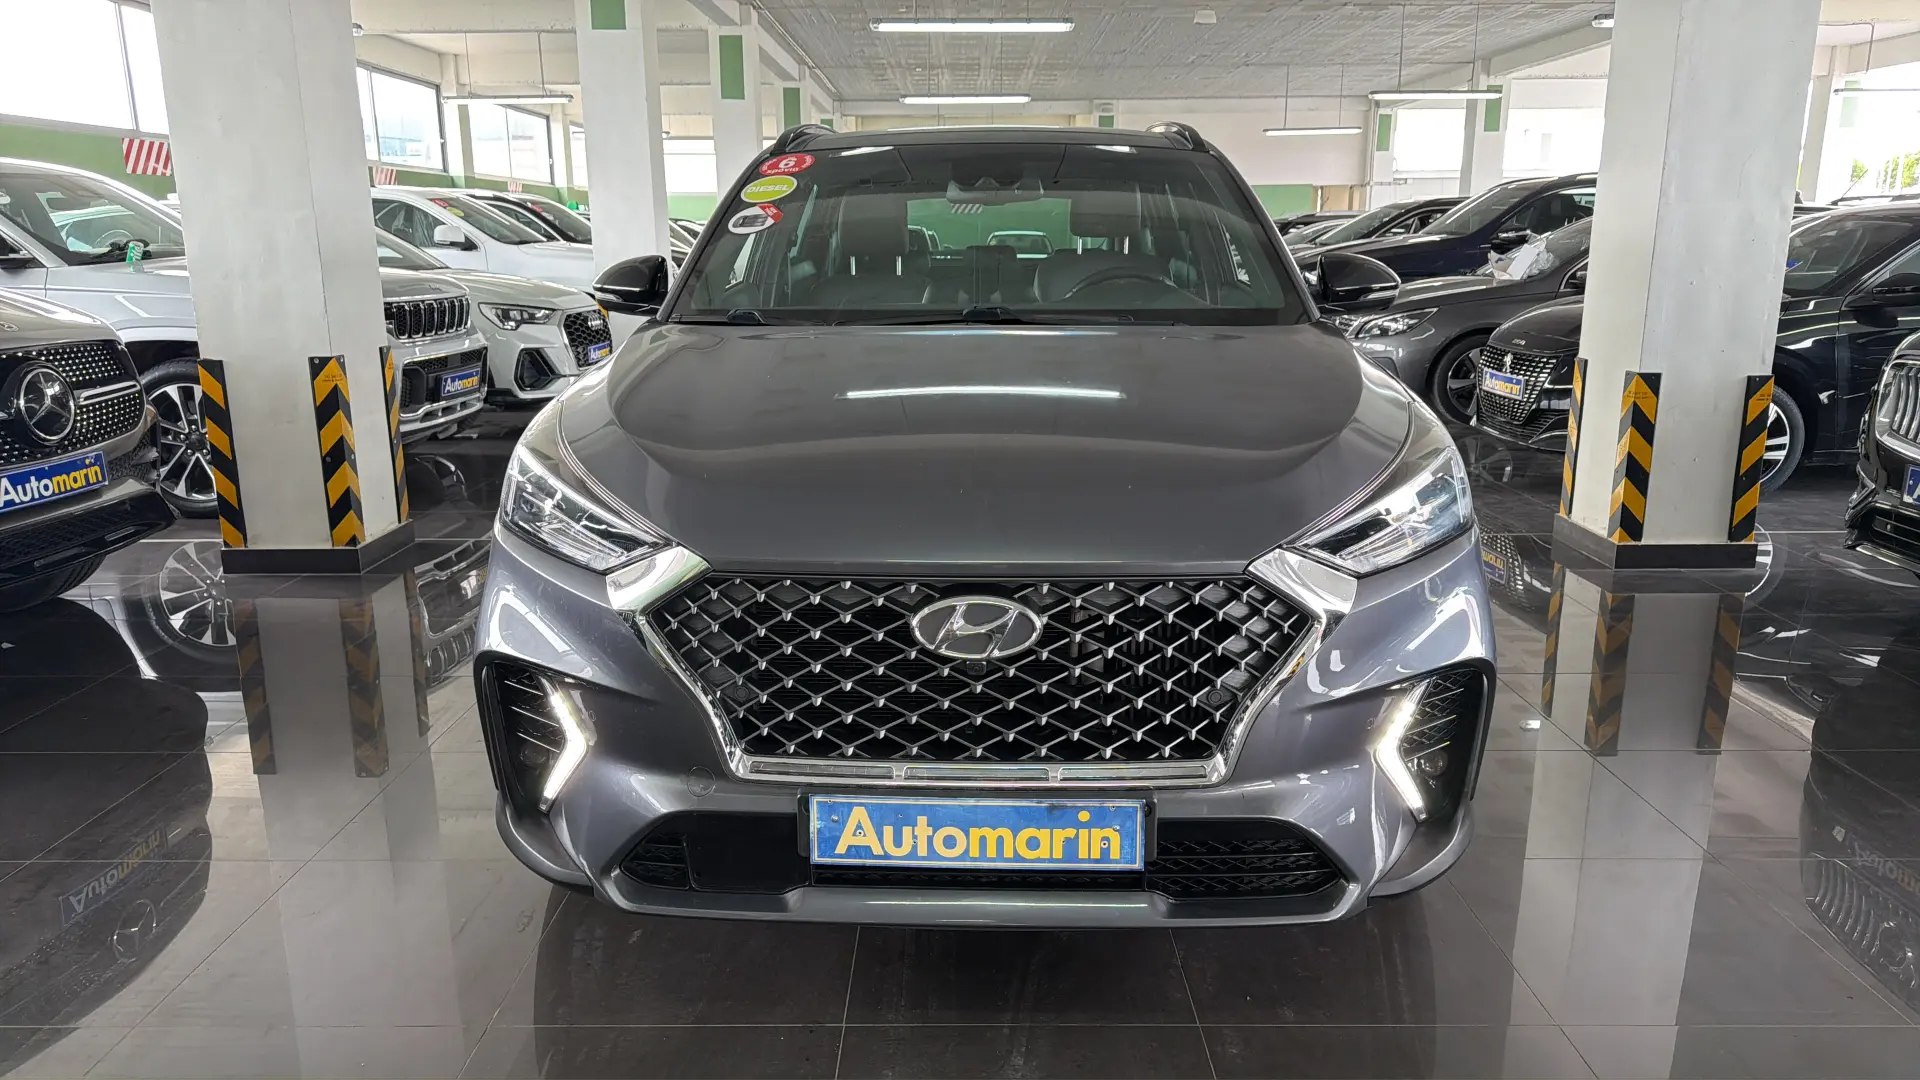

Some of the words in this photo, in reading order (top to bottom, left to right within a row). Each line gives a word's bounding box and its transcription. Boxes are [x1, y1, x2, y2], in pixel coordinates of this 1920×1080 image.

[778, 156, 798, 169] 6
[746, 184, 790, 193] DIESEL
[444, 374, 479, 394] Automarin
[1484, 371, 1521, 396] Automarin
[0, 458, 103, 508] Automarin
[834, 806, 1121, 860] Automarin
